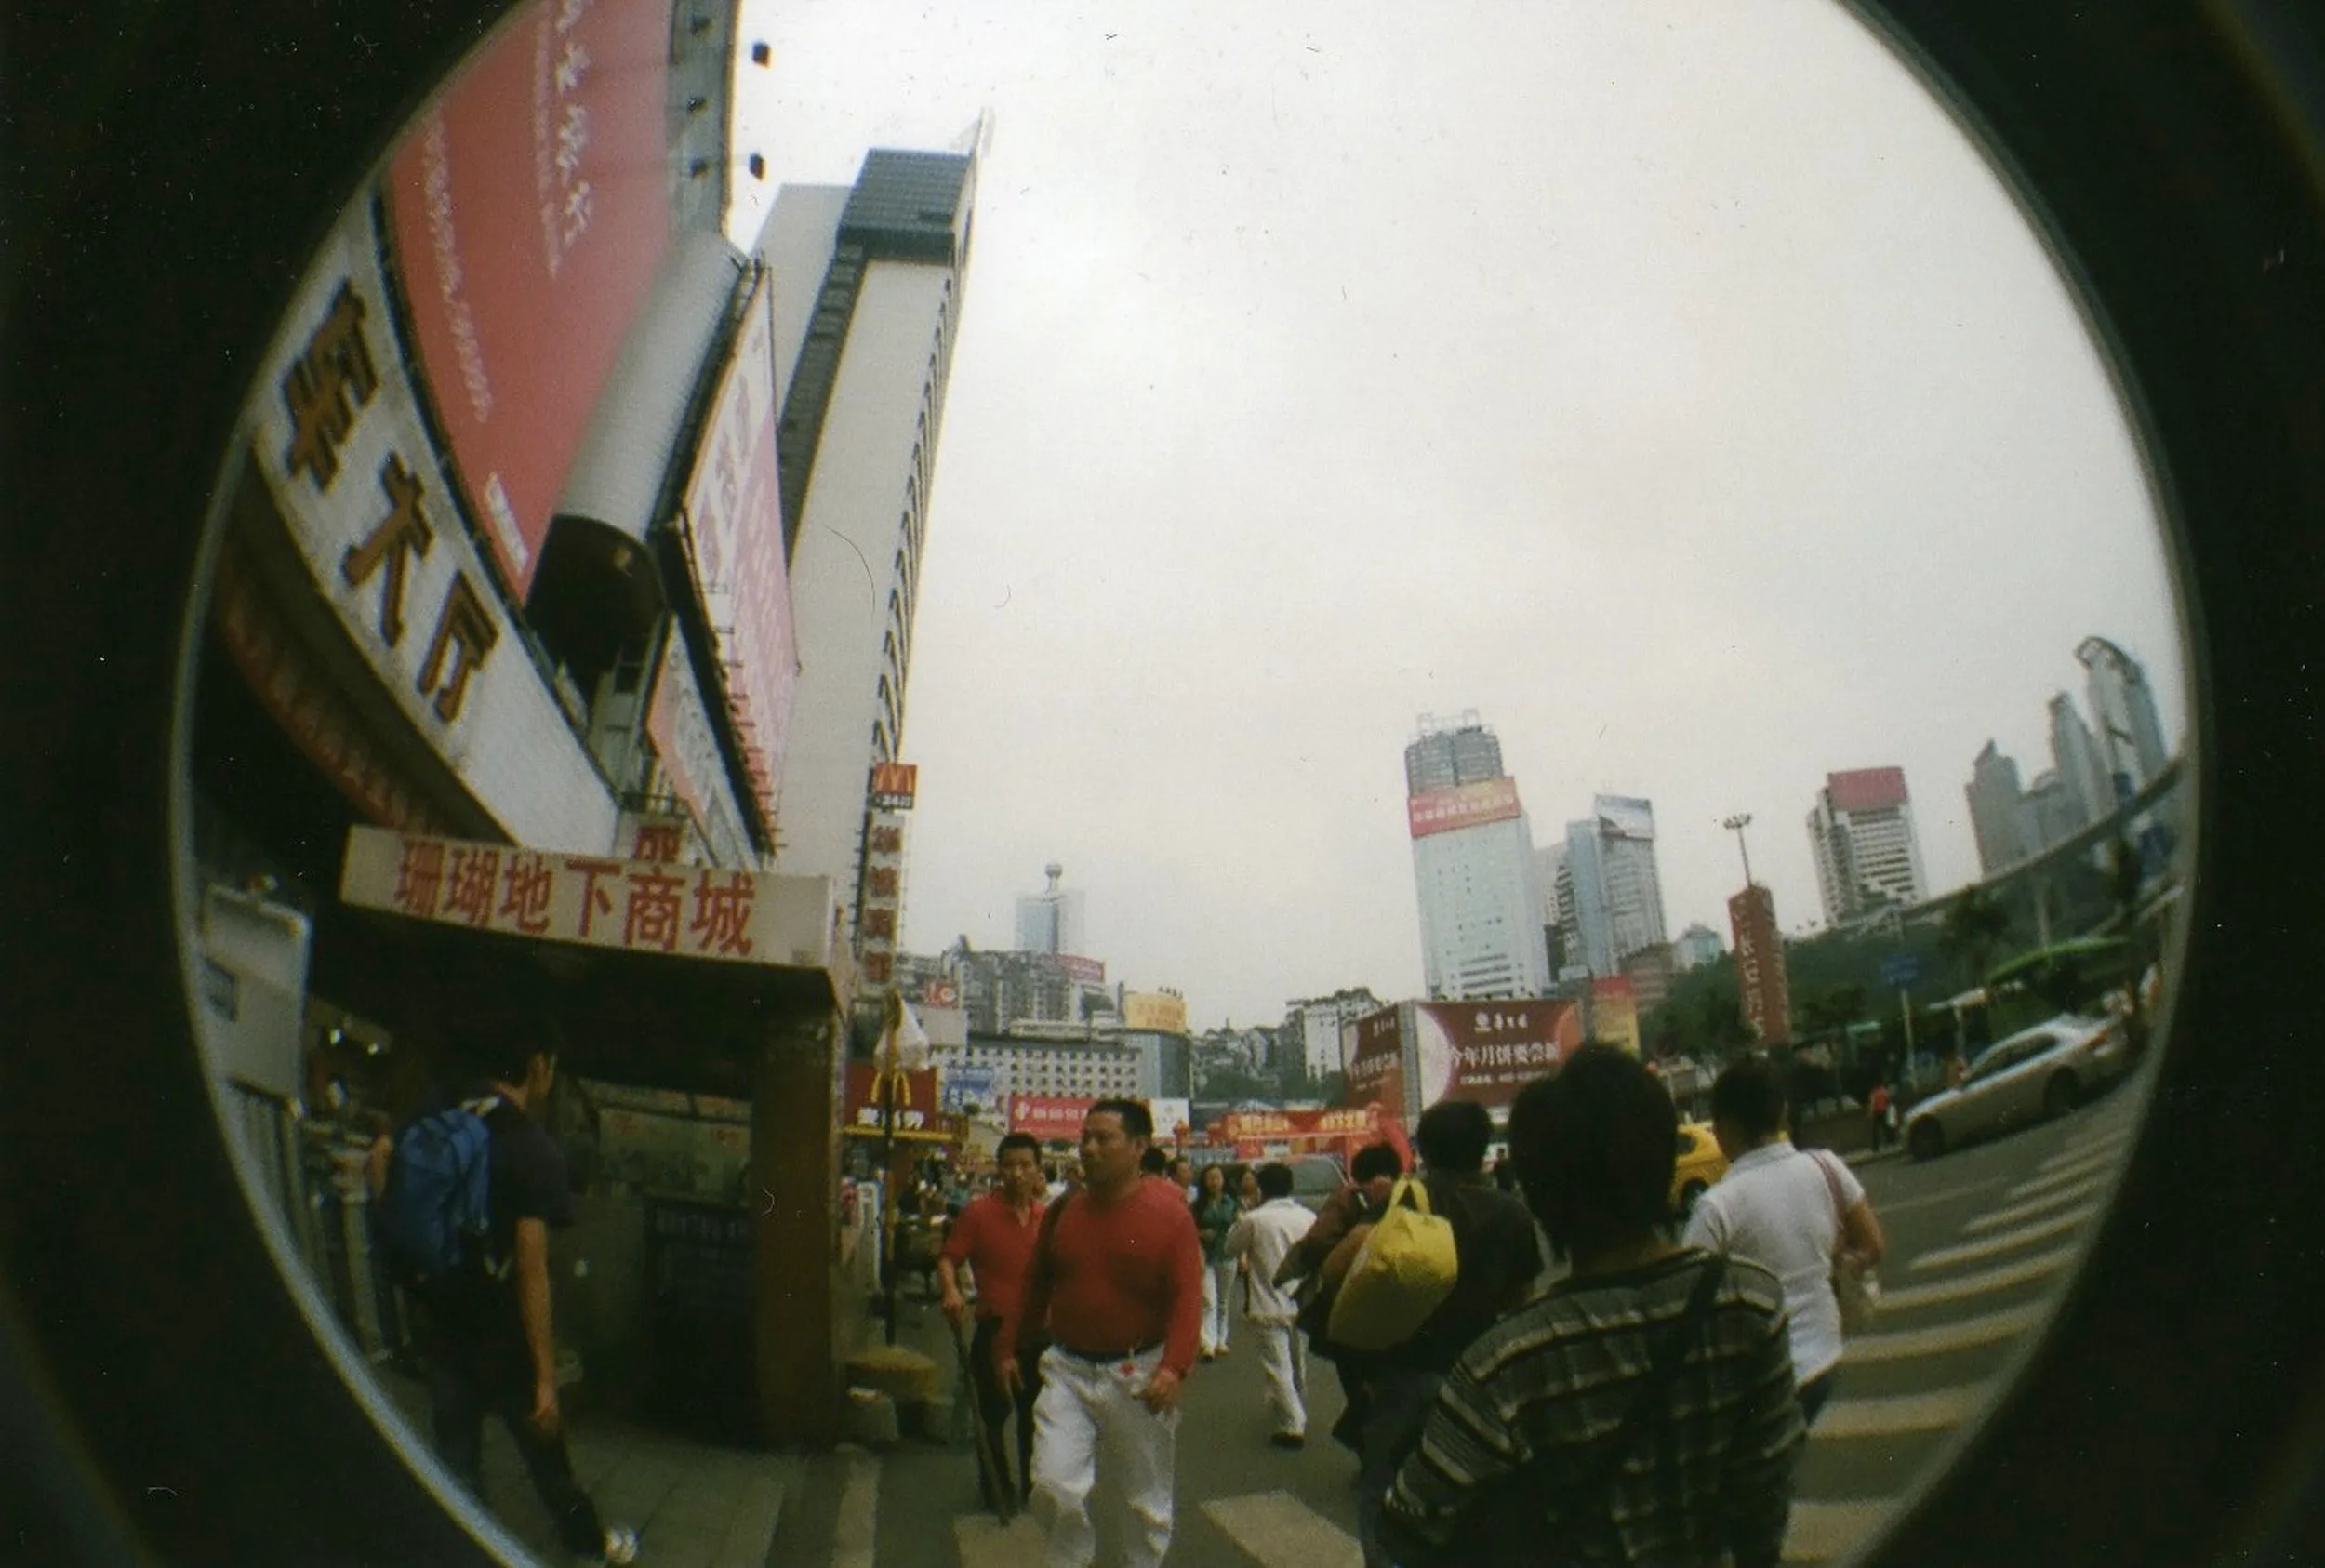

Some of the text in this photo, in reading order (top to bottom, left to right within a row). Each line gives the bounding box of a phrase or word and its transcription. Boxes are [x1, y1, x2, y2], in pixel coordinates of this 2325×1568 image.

[394, 839, 756, 955] 珊瑚地下商城
